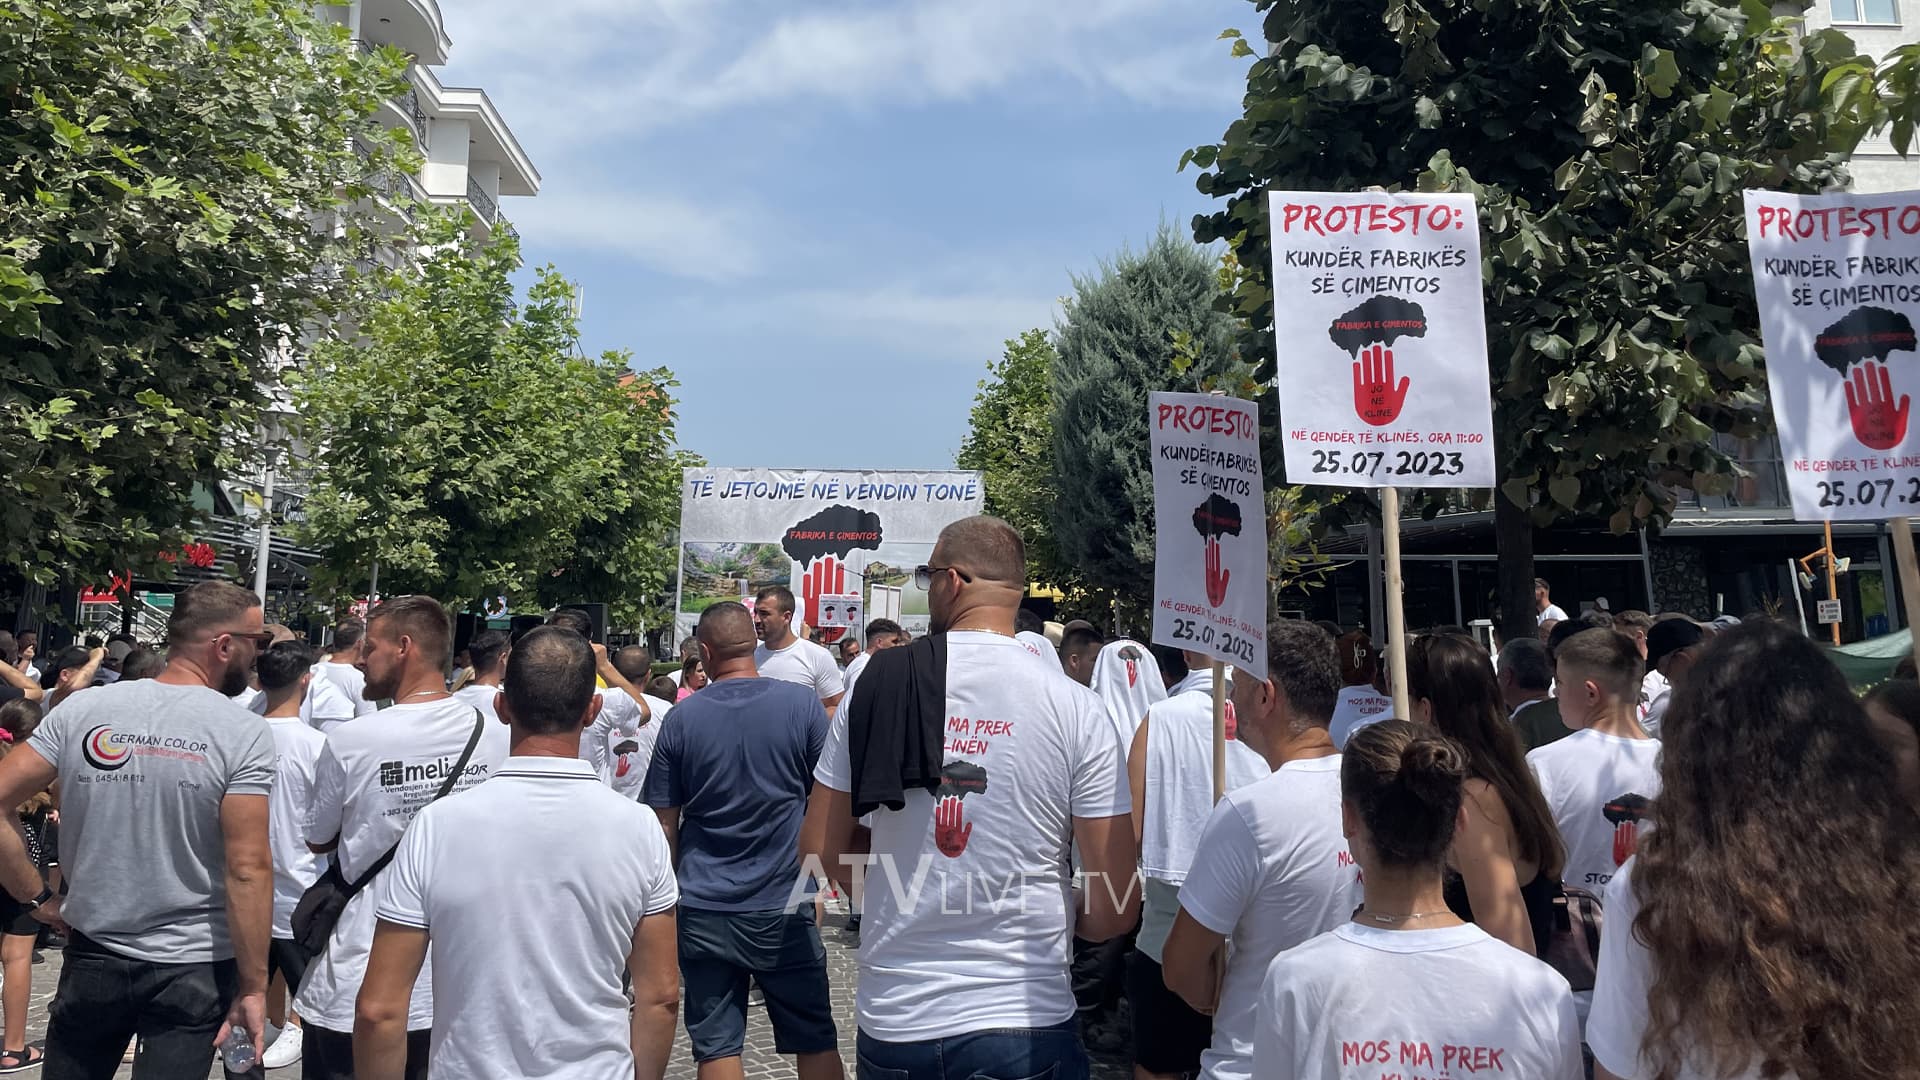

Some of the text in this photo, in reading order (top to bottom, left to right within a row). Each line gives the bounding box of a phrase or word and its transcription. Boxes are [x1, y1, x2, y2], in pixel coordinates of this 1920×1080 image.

[1283, 203, 1465, 237] PROTESTO:
[1285, 245, 1466, 270] KUNDËR FABRIKËS
[1764, 254, 1842, 280] KUNDËR
[1311, 272, 1441, 298] SË ÇIMENTOS
[1792, 282, 1814, 306] SË
[1157, 402, 1255, 441] PROTESTO:
[1291, 427, 1307, 441] NË
[1311, 429, 1356, 445] QENDËR
[1359, 429, 1373, 443] TË
[1428, 432, 1452, 445] ORA
[1456, 433, 1484, 443] 11:00
[1311, 449, 1465, 477] 25.07.2023
[1794, 457, 1809, 472] NË
[1812, 456, 1859, 473] QENDËR
[1861, 454, 1879, 470] TË
[1180, 466, 1198, 485] SË
[690, 475, 978, 502] TË JETOJMË NË VENDIN TONË
[789, 530, 826, 540] FABRIKA
[829, 531, 835, 540] E
[1160, 598, 1173, 609] NË
[1172, 618, 1254, 664] 25.07.2023
[947, 716, 1015, 737] MA PREK
[110, 733, 208, 752] GERMAN COLOR
[943, 735, 989, 755] LINËN
[406, 757, 448, 781] meli
[1342, 1040, 1504, 1073] MOS MA PREK
